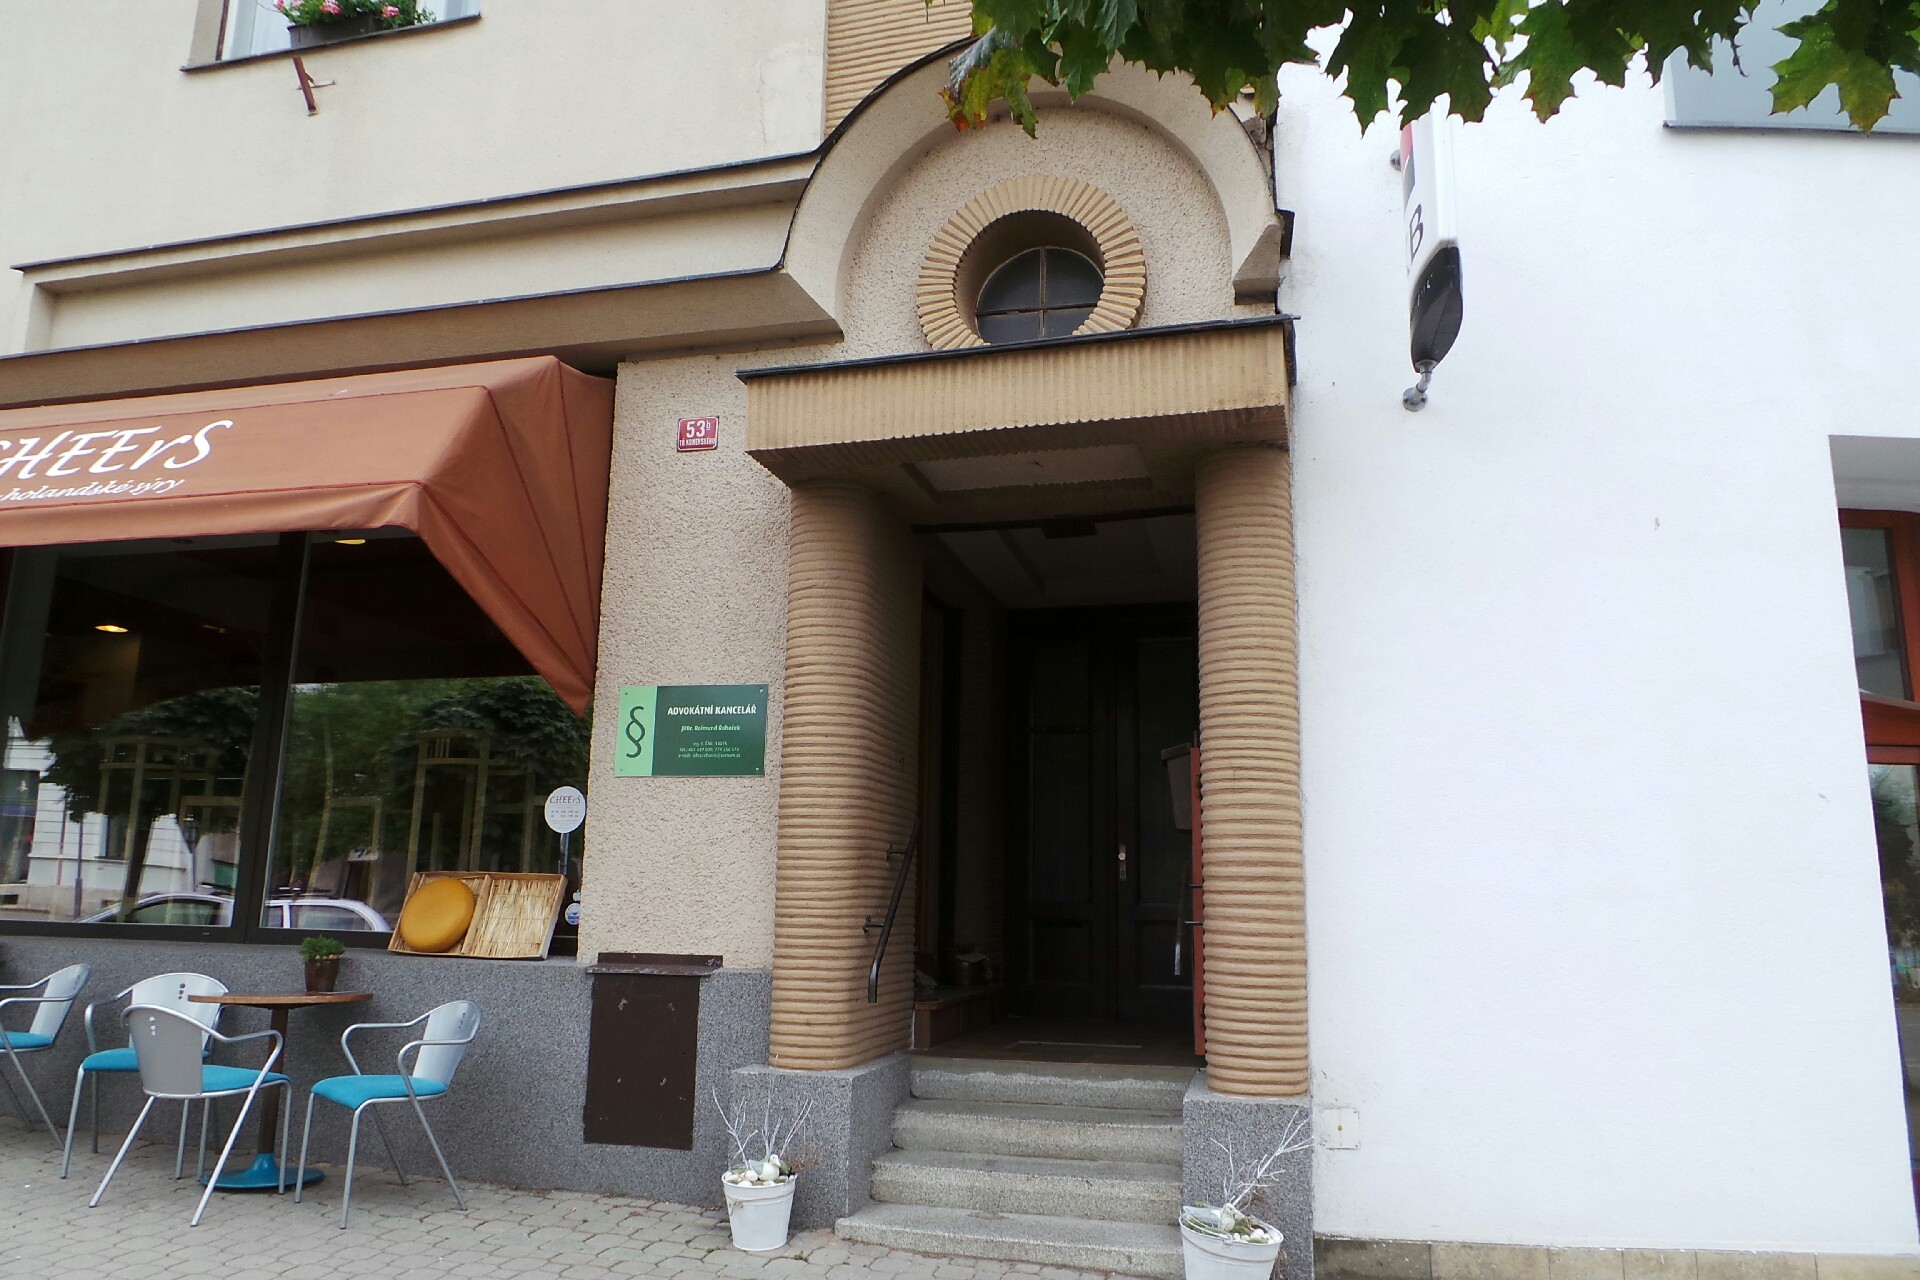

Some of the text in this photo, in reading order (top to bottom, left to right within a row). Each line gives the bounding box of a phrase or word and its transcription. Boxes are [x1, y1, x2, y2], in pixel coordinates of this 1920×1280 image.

[130, 477, 186, 496] sýry
[667, 703, 757, 716] ADVOKÁTNÍ KANCELÁŘ
